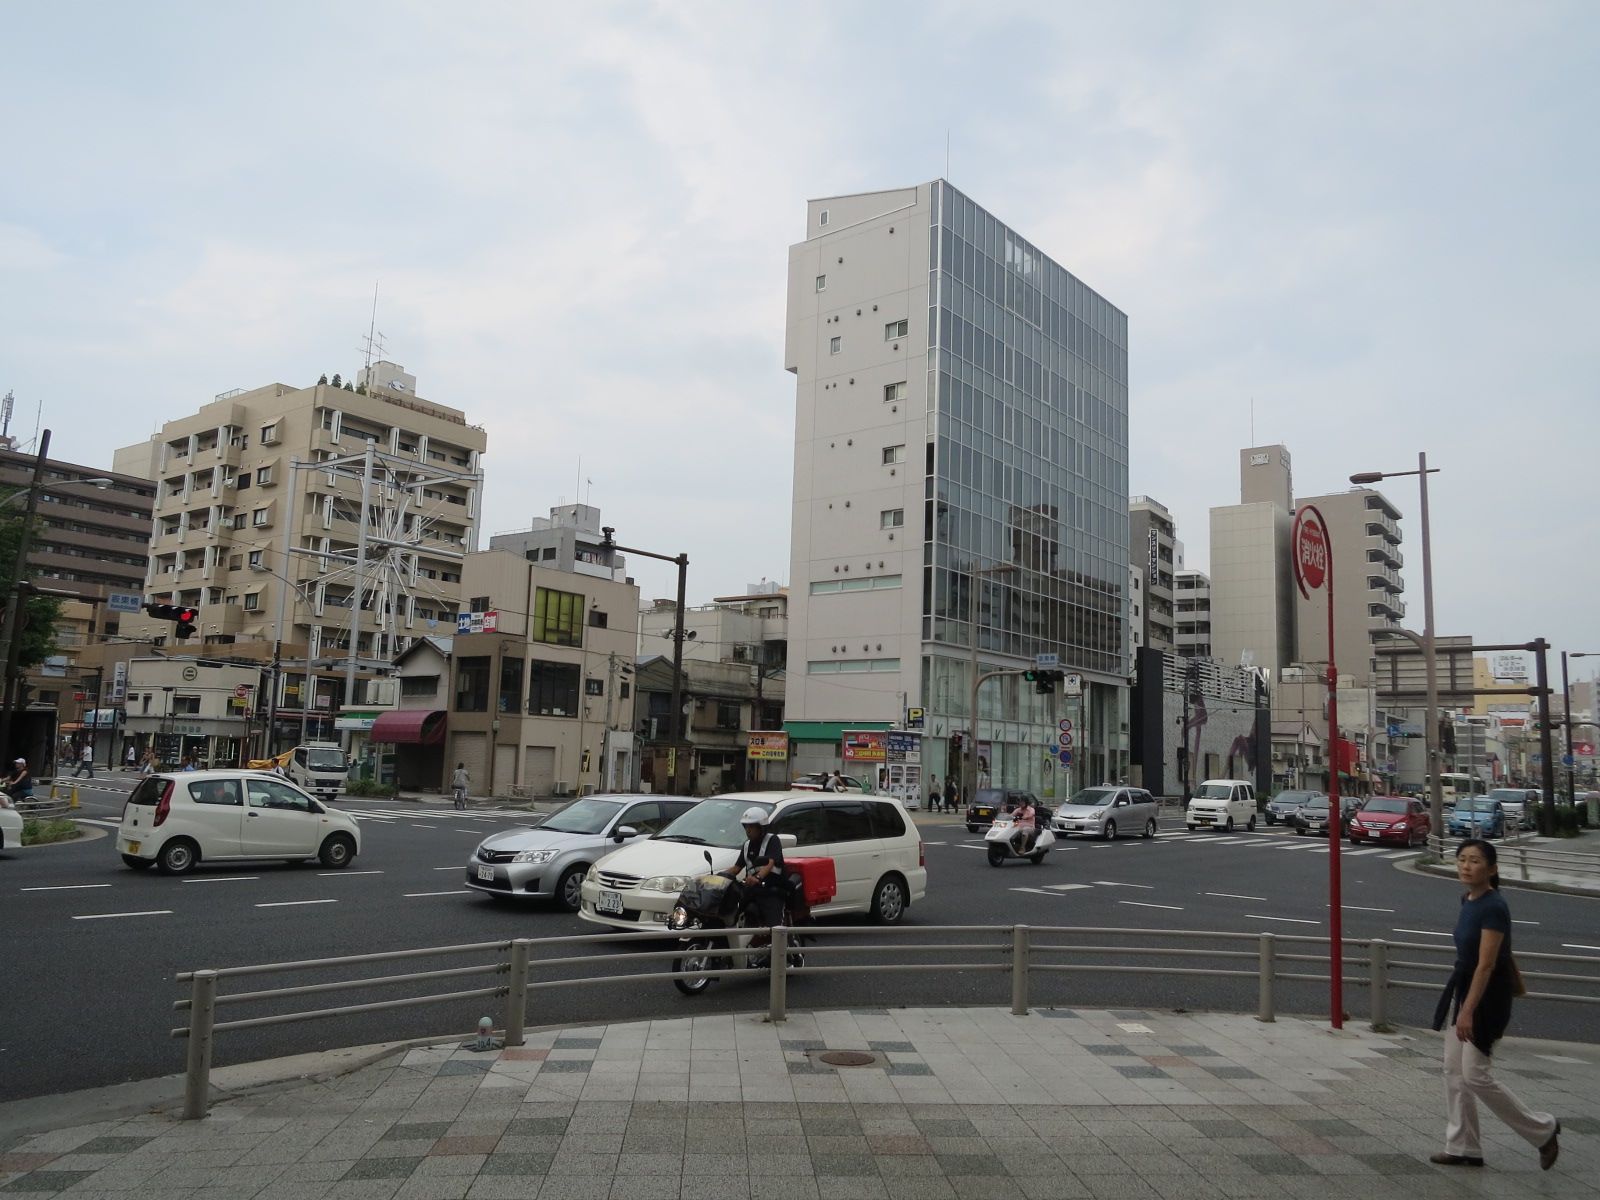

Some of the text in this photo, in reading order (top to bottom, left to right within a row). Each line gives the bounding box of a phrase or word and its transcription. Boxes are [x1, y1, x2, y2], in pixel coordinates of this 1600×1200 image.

[1301, 538, 1324, 570] 消火栓
[909, 709, 922, 721] P
